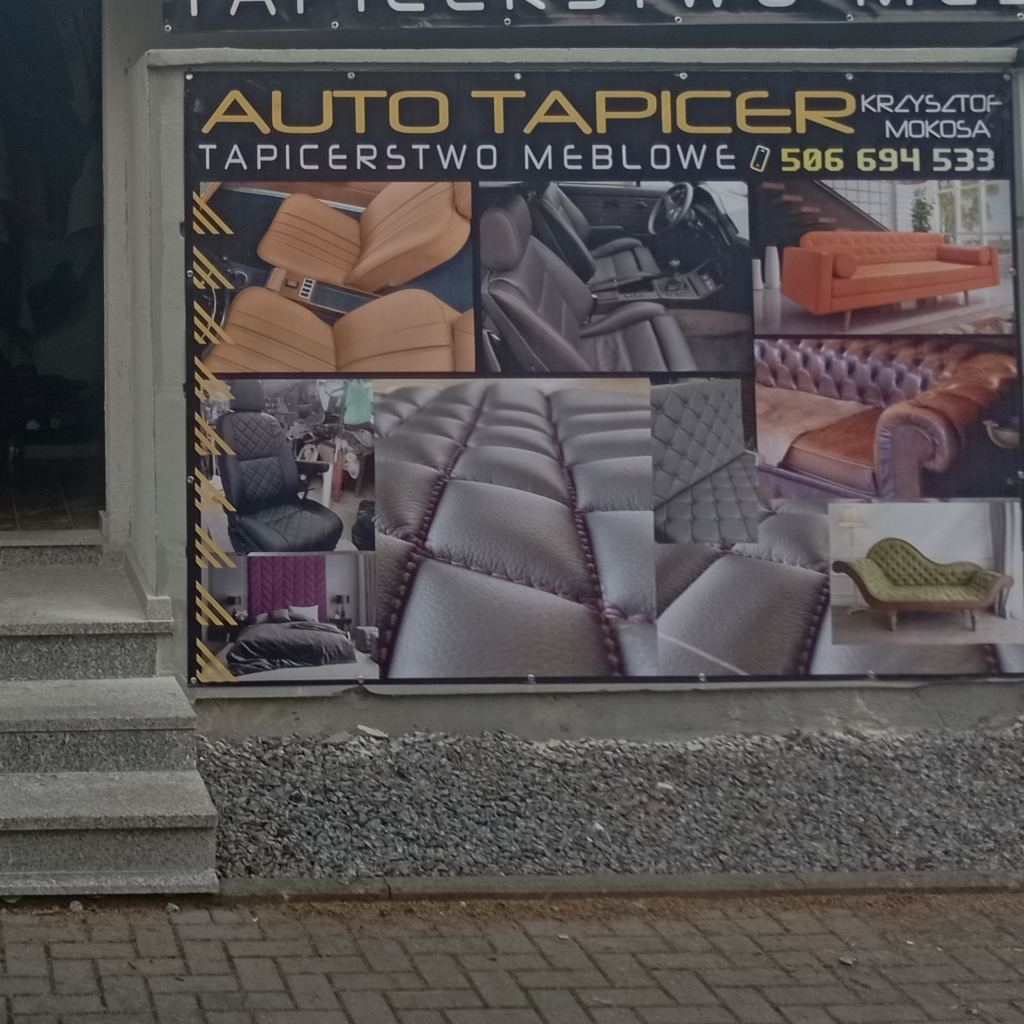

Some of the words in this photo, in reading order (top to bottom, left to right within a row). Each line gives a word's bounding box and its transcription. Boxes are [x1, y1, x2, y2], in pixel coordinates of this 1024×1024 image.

[201, 89, 450, 134] AUTO
[471, 89, 857, 134] TAPICER
[860, 93, 1003, 114] KRZYSZTOF
[884, 119, 992, 139] MOKOSA
[198, 144, 498, 171] TAPICERSTWO
[524, 143, 736, 170] MEBLOWE
[781, 148, 844, 172] 506
[856, 148, 921, 172] 694
[932, 147, 996, 172] 533
